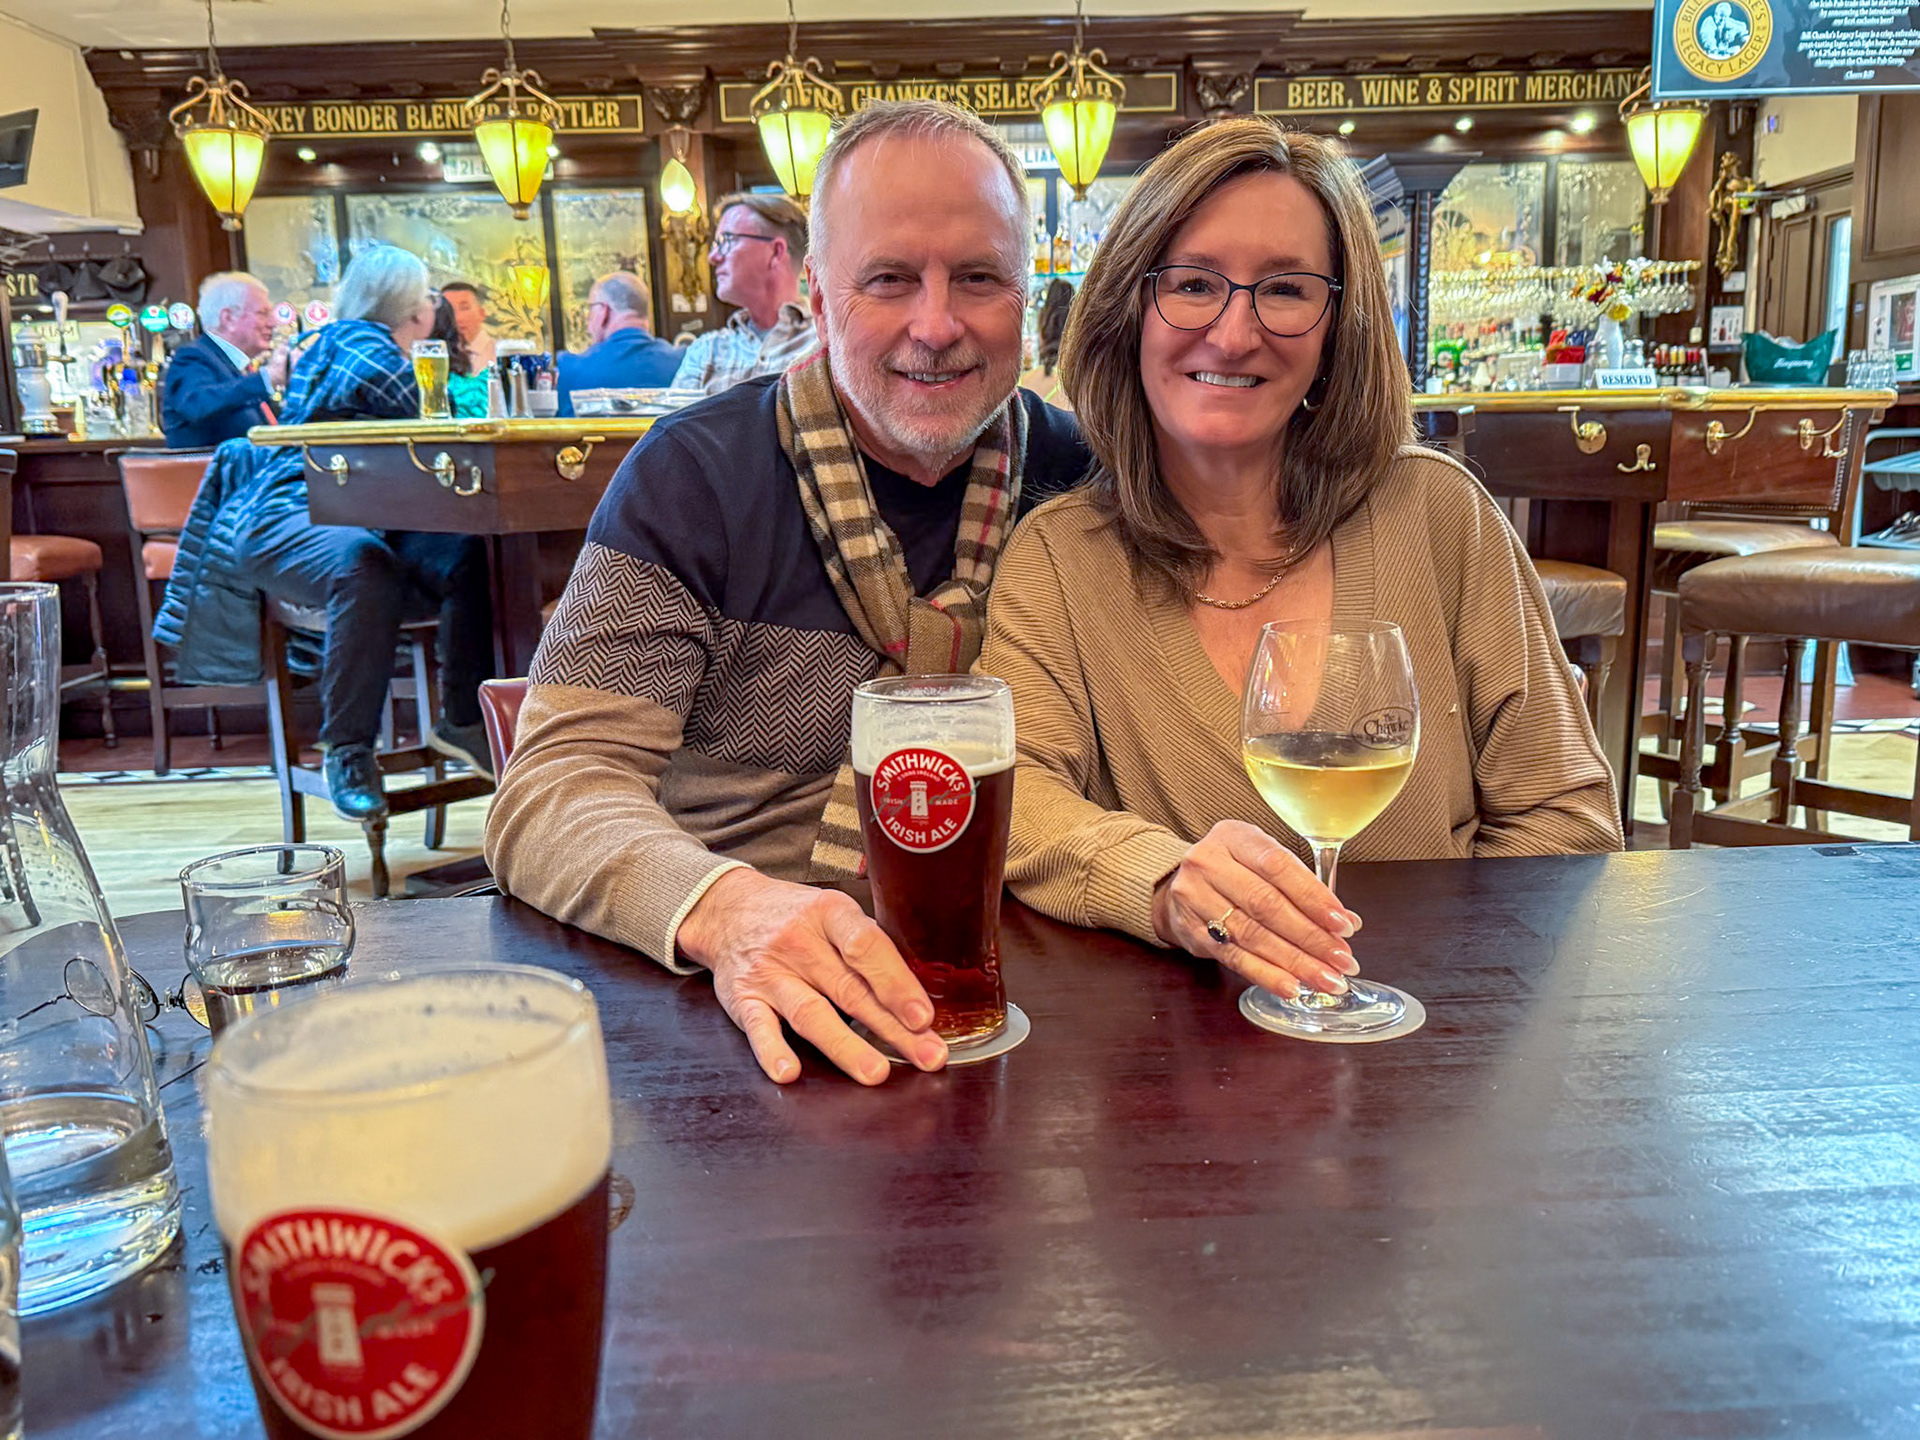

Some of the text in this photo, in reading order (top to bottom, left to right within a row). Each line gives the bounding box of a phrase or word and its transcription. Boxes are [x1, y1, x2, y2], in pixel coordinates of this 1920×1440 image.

[1681, 34, 1764, 74] LEGACY LAGER
[1287, 82, 1354, 109] BEER,
[1362, 79, 1420, 106] WINE
[1426, 77, 1443, 105] &
[1448, 76, 1520, 104] SPIRIT
[313, 104, 398, 132] BONDER
[1601, 374, 1652, 385] RESERVED
[885, 815, 958, 844] IRISH ALE
[371, 1361, 439, 1422] ALE
